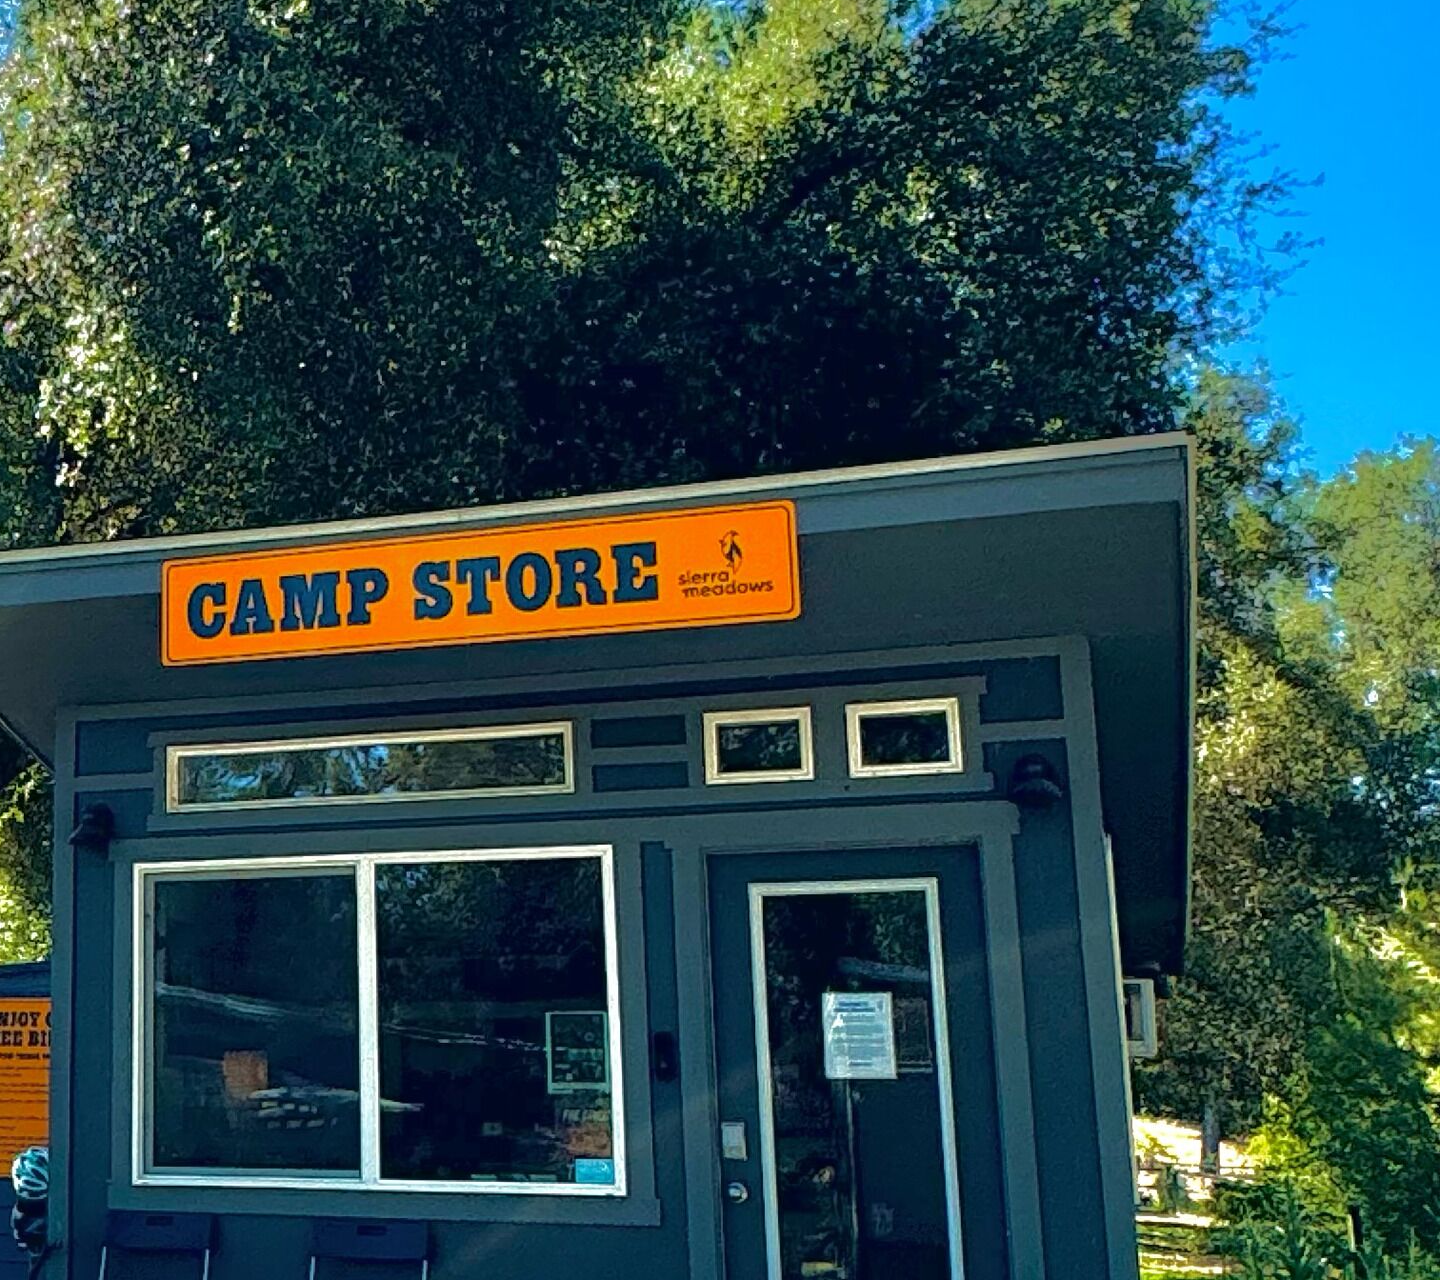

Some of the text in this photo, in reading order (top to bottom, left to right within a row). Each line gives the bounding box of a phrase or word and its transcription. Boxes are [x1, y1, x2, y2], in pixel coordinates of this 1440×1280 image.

[678, 570, 729, 586] sierra
[187, 541, 659, 640] CAMP STORE
[682, 579, 774, 598] meadows
